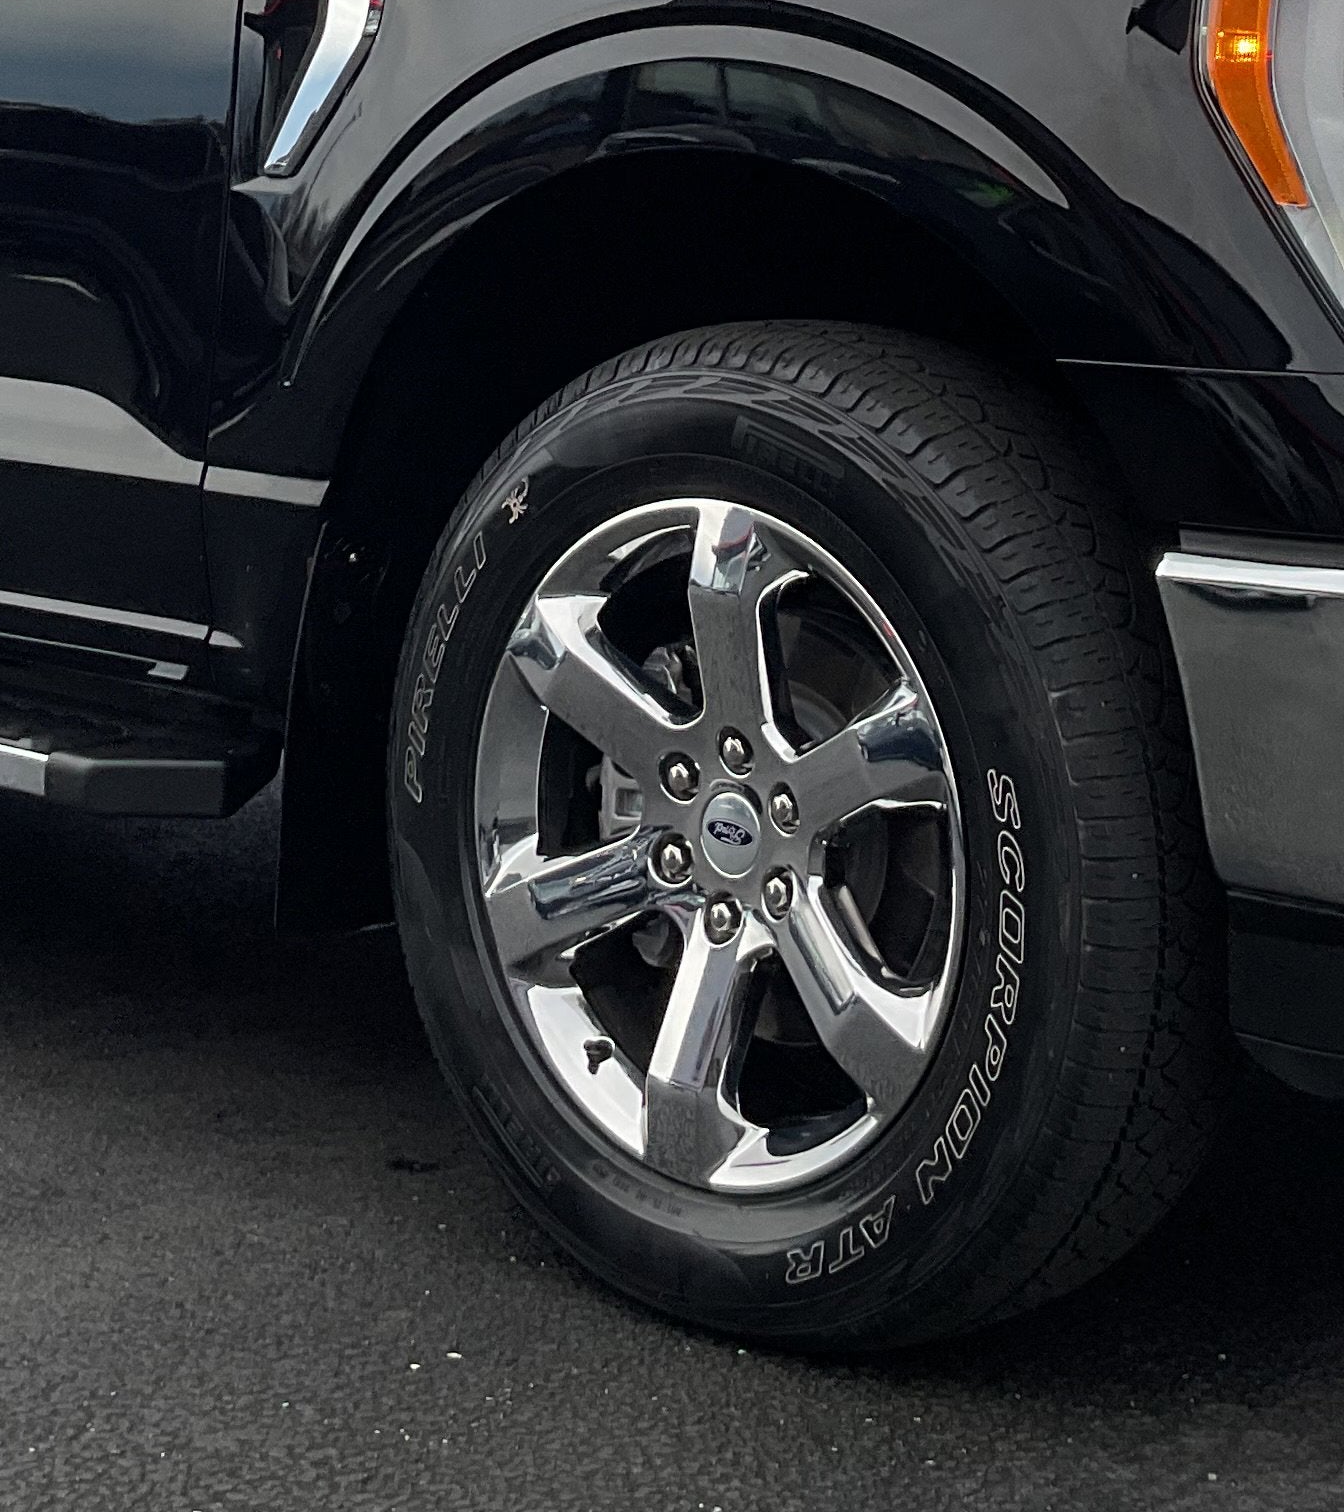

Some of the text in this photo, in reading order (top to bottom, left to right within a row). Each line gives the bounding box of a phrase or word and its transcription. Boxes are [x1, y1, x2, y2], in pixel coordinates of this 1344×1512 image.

[405, 530, 487, 804] PIRELLI
[712, 821, 746, 846] Ford
[785, 767, 1026, 1284] SCORPION ATR
